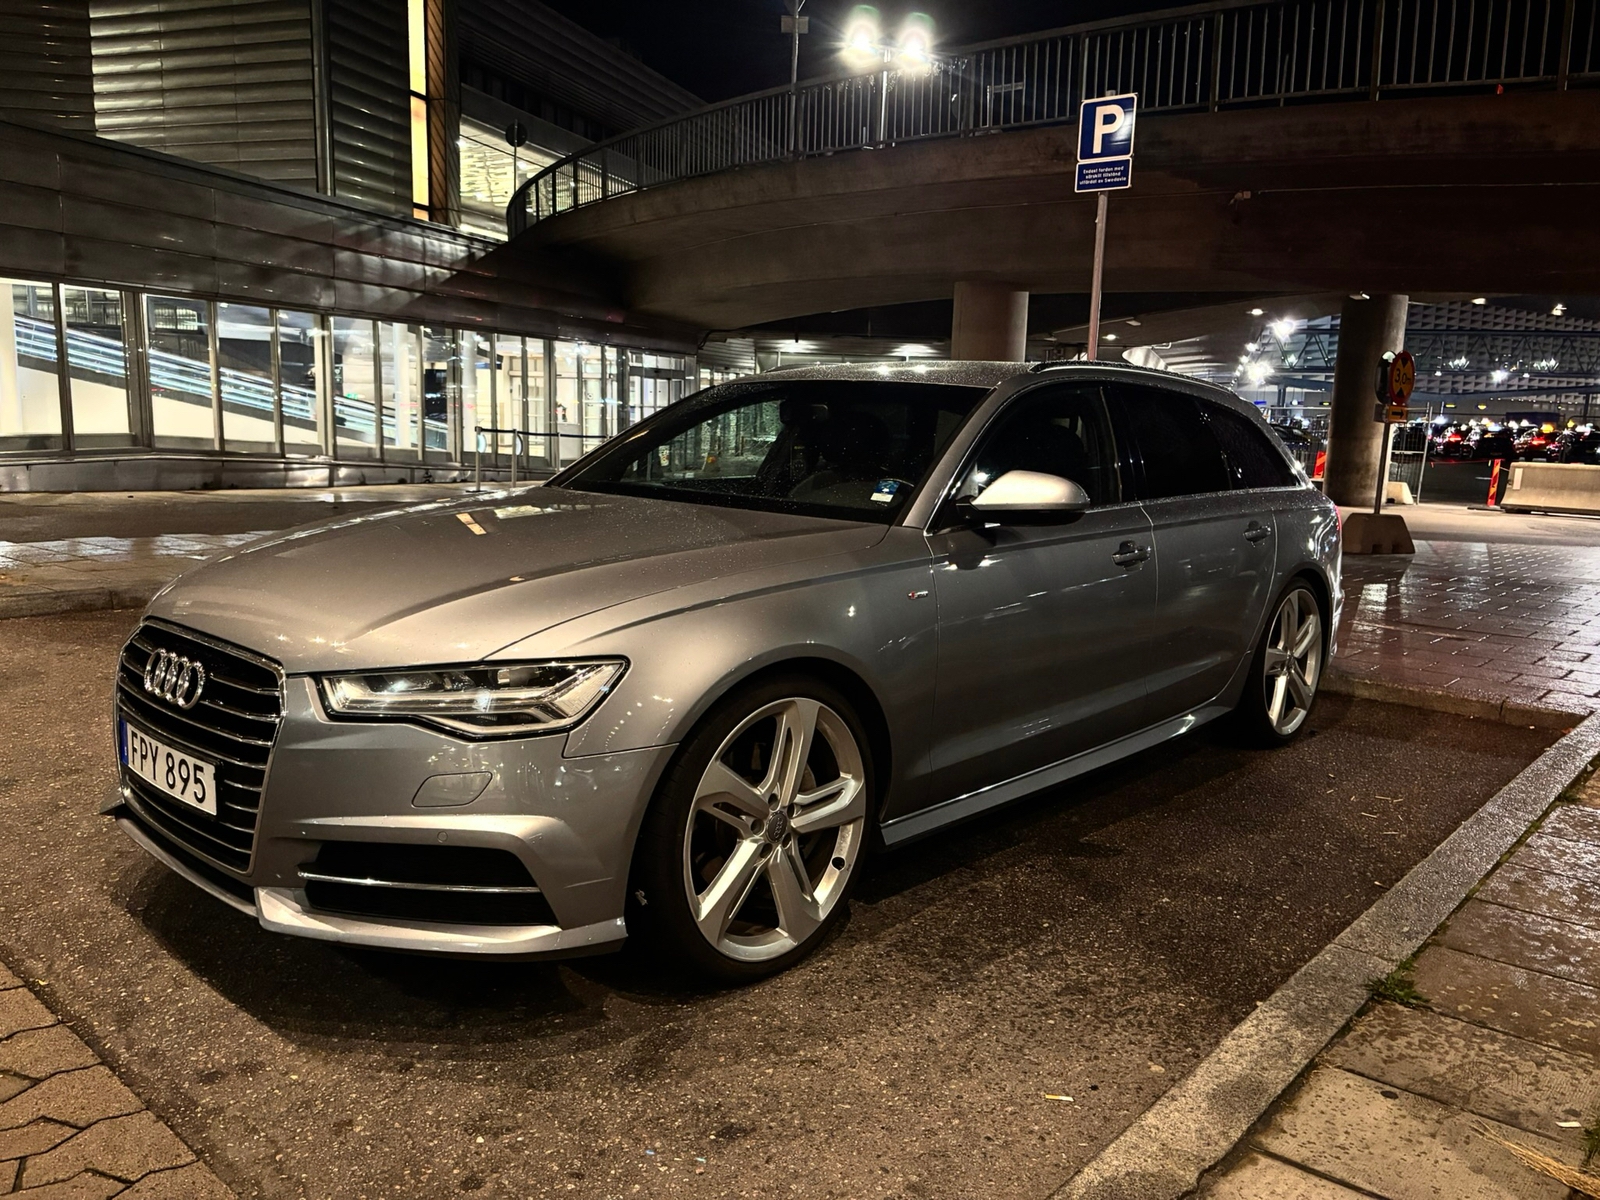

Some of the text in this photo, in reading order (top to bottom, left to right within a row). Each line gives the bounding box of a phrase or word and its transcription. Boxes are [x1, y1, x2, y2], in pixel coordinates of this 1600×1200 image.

[1092, 104, 1124, 154] P
[131, 730, 206, 804] FPY 895
